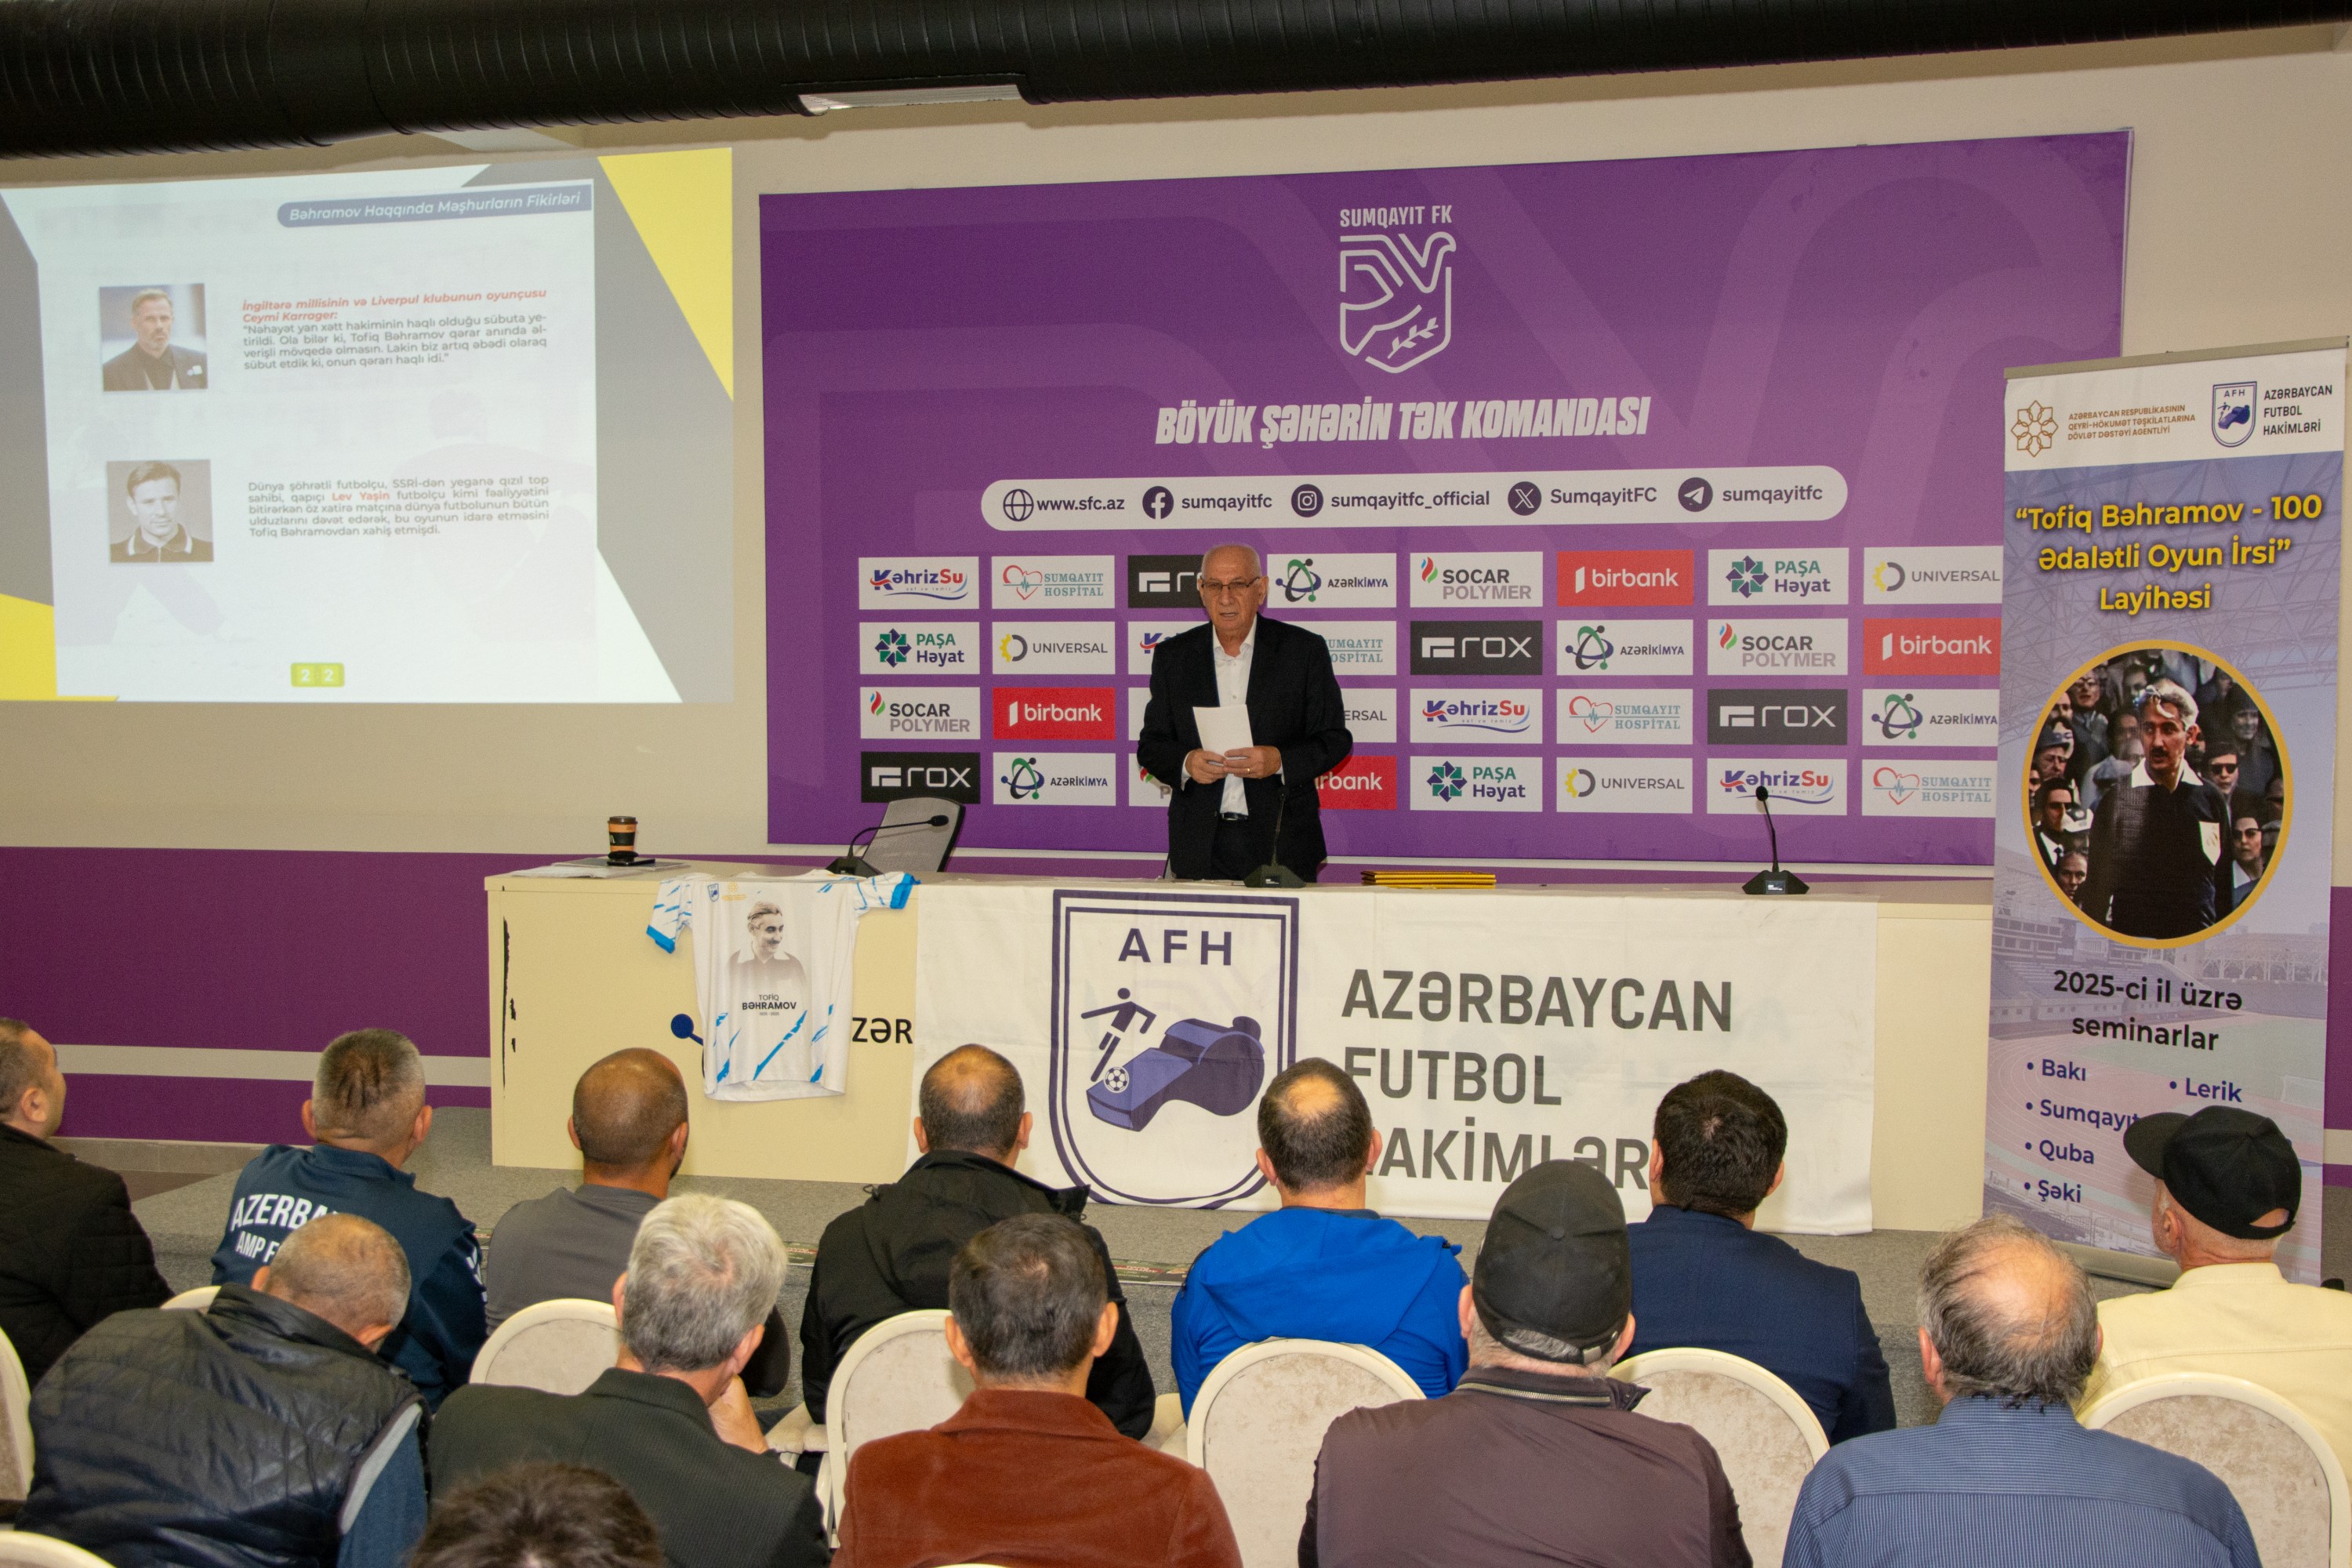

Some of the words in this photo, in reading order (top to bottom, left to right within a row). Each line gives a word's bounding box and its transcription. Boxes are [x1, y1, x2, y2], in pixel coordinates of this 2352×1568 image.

[290, 208, 361, 220] Bəhramov
[365, 203, 434, 220] Haqqında
[438, 198, 522, 215] Məşhurların
[526, 191, 581, 207] Fikirləri
[1341, 206, 1425, 229] SUMQAYIT
[1432, 205, 1452, 223] FK
[242, 300, 292, 313] İngiltərə
[296, 297, 349, 309] millisinin
[371, 295, 419, 306] Liverpul
[423, 292, 481, 303] klubunun
[487, 290, 546, 302] oyunçusu
[243, 313, 278, 324] Ceymi
[282, 311, 338, 322] Karrager:
[298, 324, 318, 334] yan
[321, 321, 343, 331] xətt
[346, 319, 404, 331] hakiminin
[407, 318, 435, 328] haqlı
[438, 316, 481, 327] olduğu
[484, 314, 525, 325] sübuta
[528, 314, 546, 324] ye-
[244, 336, 274, 346] tirildi.
[280, 334, 298, 345] Ola
[304, 334, 328, 343] bilər
[334, 333, 346, 343] ki,
[350, 332, 379, 343] Tofiq
[385, 330, 445, 341] Bəhramov
[449, 328, 481, 339] qərar
[485, 325, 526, 336] anında
[532, 325, 546, 334] əl-
[244, 347, 275, 359] verişli
[280, 347, 332, 357] mövqedə
[336, 345, 383, 354] olmasın.
[387, 342, 418, 353] Lakin
[422, 342, 437, 351] biz
[442, 341, 469, 350] artıq
[473, 339, 506, 349] əbədi
[510, 337, 546, 347] olaraq
[244, 358, 277, 369] sübut
[280, 357, 308, 368] etdik
[312, 357, 324, 368] ki,
[326, 358, 356, 367] onun
[360, 356, 393, 367] qərarı
[397, 355, 424, 365] haqlı
[2264, 385, 2332, 400] AZƏRBAYCAN
[2069, 411, 2119, 419] AZƏRBAYCAN
[2264, 406, 2302, 418] FUTBOL
[1155, 399, 1257, 444] BÖYÜK
[1260, 396, 1393, 448] ŞƏHƏRİN
[1399, 401, 1458, 440] TƏK
[1461, 397, 1651, 438] KOMANDASI
[2068, 419, 2131, 430] QEYRİ-HÖKUMƏT
[2133, 415, 2195, 426] TƏŞKİLATLARINA
[2263, 419, 2321, 435] HAKİMLƏRİ
[2068, 431, 2096, 440] DÖVLƏT
[2099, 429, 2130, 437] DƏSTƏYİ
[2132, 426, 2170, 435] AGENTLİYİ
[249, 482, 284, 492] Dünya
[290, 481, 331, 492] şöhrətli
[337, 480, 387, 490] futbolçu,
[393, 478, 445, 488] SSRİ-dən
[451, 478, 494, 488] yeganə
[499, 476, 523, 486] qızıl
[528, 476, 549, 486] top
[249, 493, 284, 503] sahibi,
[291, 493, 325, 503] qapıçı
[332, 492, 352, 501] Lev
[360, 492, 390, 502] Yaşin
[397, 490, 445, 501] futbolçu
[453, 489, 478, 498] kimi
[485, 487, 548, 499] fəaliyyətini
[1037, 496, 1125, 510] www.sfc.az
[1181, 494, 1272, 511] sumqayitfc
[1331, 491, 1490, 510] sumqayitfc_official
[1550, 487, 1657, 506] SumqayitFC
[1722, 485, 1823, 503] sumqayitfc
[249, 504, 303, 514] bitirərkən
[306, 503, 318, 514] öz
[321, 503, 352, 512] xatirə
[356, 502, 402, 514] matçına
[405, 502, 441, 513] dünya
[444, 501, 510, 510] futbolunun
[513, 499, 548, 508] bütün
[2102, 503, 2245, 528] Bəhramov
[2270, 495, 2322, 520] 100
[249, 516, 307, 525] ulduzlarını
[313, 515, 343, 524] dəvət
[348, 514, 390, 524] edərək,
[395, 514, 409, 523] bu
[414, 514, 458, 524] oyunun
[464, 512, 492, 521] idarə
[498, 510, 549, 521] etməsini
[250, 528, 277, 537] Tofiq
[281, 526, 359, 536] Bəhramovdan
[363, 525, 392, 536] xahiş
[394, 525, 441, 535] etmişdi.
[2039, 545, 2140, 570] Ədalətli
[2147, 544, 2223, 572] Oyun
[1443, 569, 1509, 584] SOCAR
[1775, 561, 1820, 577] PAŞA
[1911, 570, 2001, 583] UNIVERSAL
[870, 569, 963, 590] KəhrizSu
[1044, 573, 1103, 583] SUMQAYIT
[1327, 577, 1388, 588] AZƏRİKİMYA
[1592, 568, 1679, 587] birbank
[1044, 585, 1103, 597] HOSPİTAL
[1443, 586, 1531, 600] POLYMER
[1775, 579, 1831, 597] Həyat
[2100, 583, 2212, 615] Layihəsi
[916, 633, 956, 648] PAŞA
[1033, 643, 1108, 653] UNIVERSAL
[1742, 637, 1813, 652] SOCAR
[1900, 635, 1992, 655] birbank
[916, 650, 964, 664] Həyat
[1621, 645, 1684, 656] AZƏRİKİMYA
[1742, 653, 1835, 667] POLYMER
[890, 704, 949, 717] SOCAR
[1025, 704, 1102, 723] birbank
[1422, 700, 1525, 722] KəhrizSu
[1614, 706, 1680, 715] SUMQAYIT
[890, 719, 970, 733] POLYMER
[1615, 717, 1680, 730] HOSPİTAL
[1930, 713, 1998, 725] AZƏRİKİMYA
[1051, 775, 1108, 786] AZƏRİKİMYA
[1473, 768, 1516, 782] PAŞA
[1720, 771, 1828, 793] KəhrizSu
[1922, 777, 1991, 787] SUMQAYIT
[1602, 779, 1684, 789] UNIVERSAL
[1473, 785, 1526, 802] Həyat
[1922, 789, 1991, 801] HOSPİTAL
[1118, 928, 1233, 967] AFH
[2053, 969, 2147, 1000] 2025-ci
[2157, 978, 2171, 1003] il
[2181, 982, 2242, 1011] üzrə
[1341, 968, 1732, 1033] AZƏRBAYCAN
[851, 1017, 913, 1044] ZƏR
[2072, 1017, 2219, 1050] seminarlar
[1344, 1047, 1562, 1106] FUTBOL
[2042, 1059, 2086, 1081] Bakı
[2185, 1077, 2242, 1102] Lerik
[2039, 1140, 2094, 1164] Quba
[2038, 1179, 2081, 1203] Şəki
[236, 1231, 266, 1258] AMP
